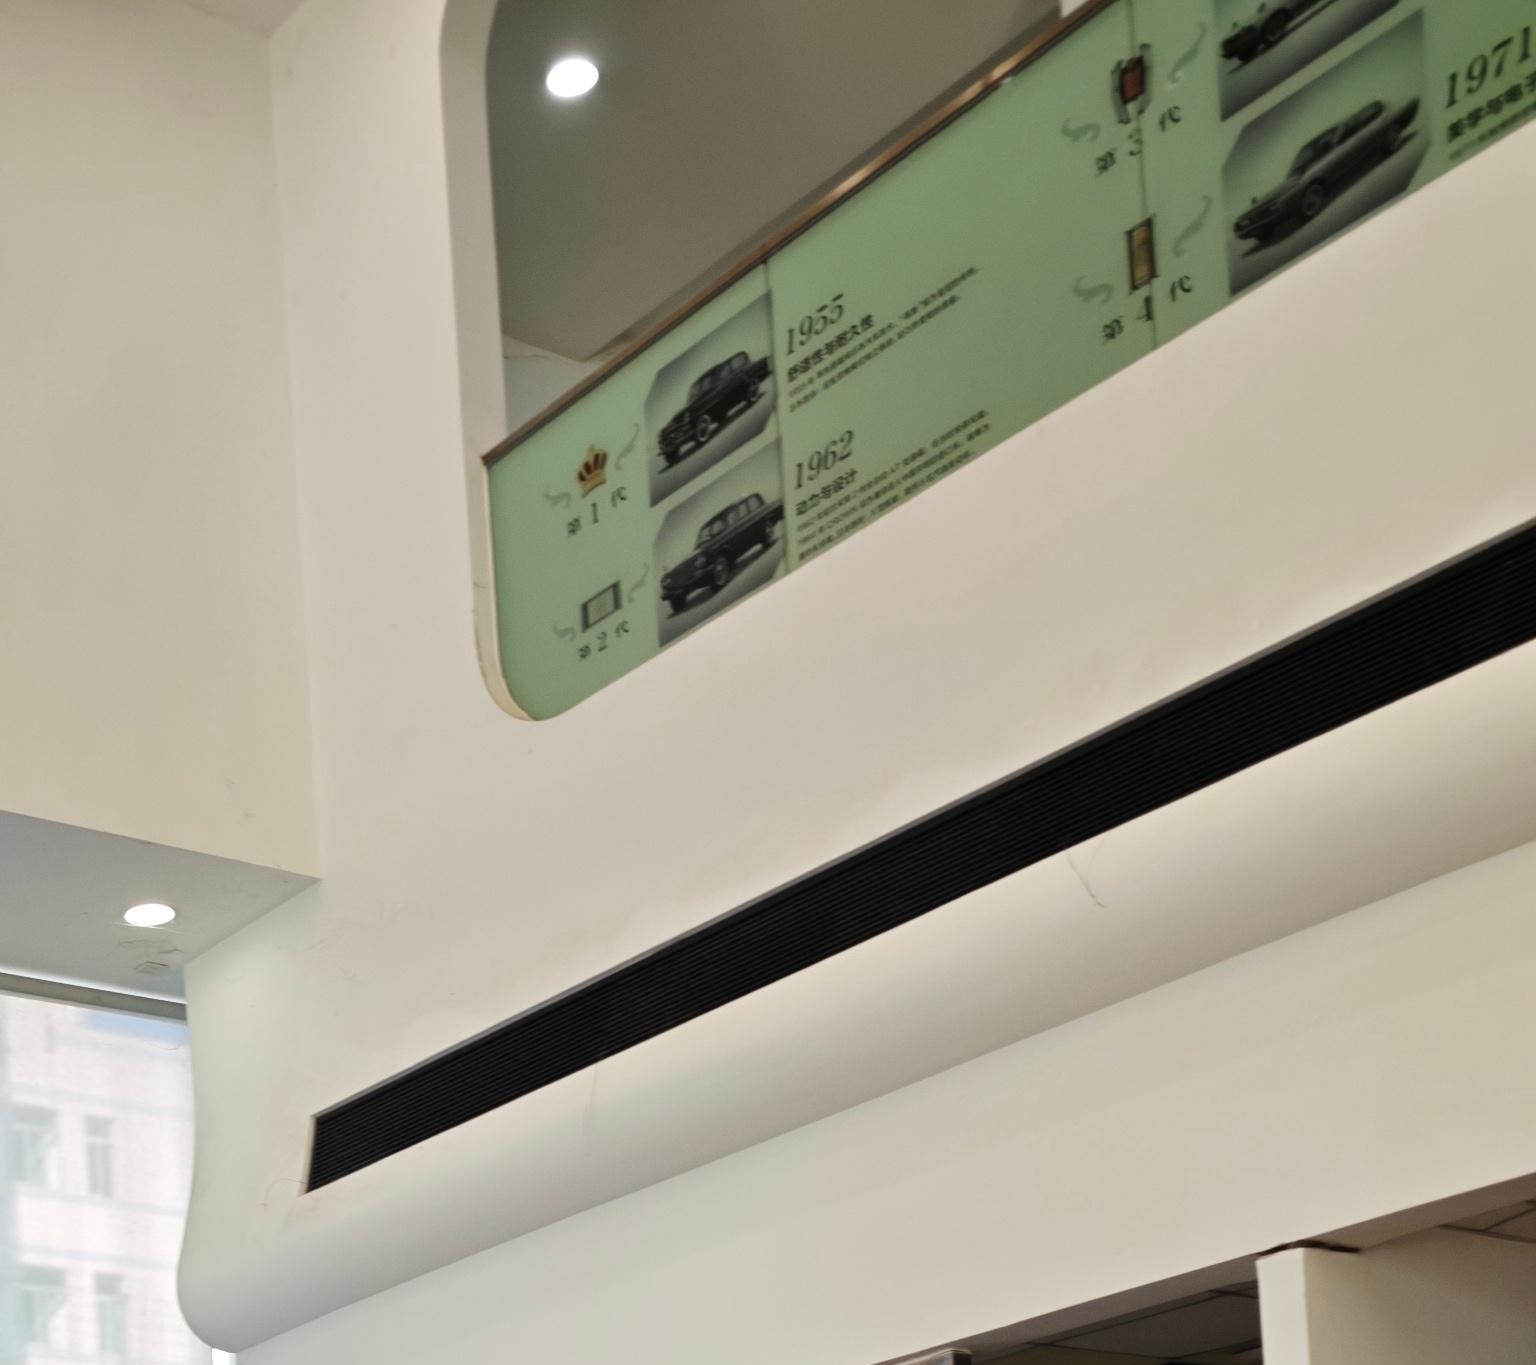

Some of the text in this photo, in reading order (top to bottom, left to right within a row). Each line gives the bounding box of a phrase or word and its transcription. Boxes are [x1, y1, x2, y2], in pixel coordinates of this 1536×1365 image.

[1446, 25, 1531, 109] 1971
[786, 293, 844, 355] 1955
[795, 430, 855, 489] 1962
[567, 487, 628, 537] 第1代
[577, 620, 630, 661] 第2代
